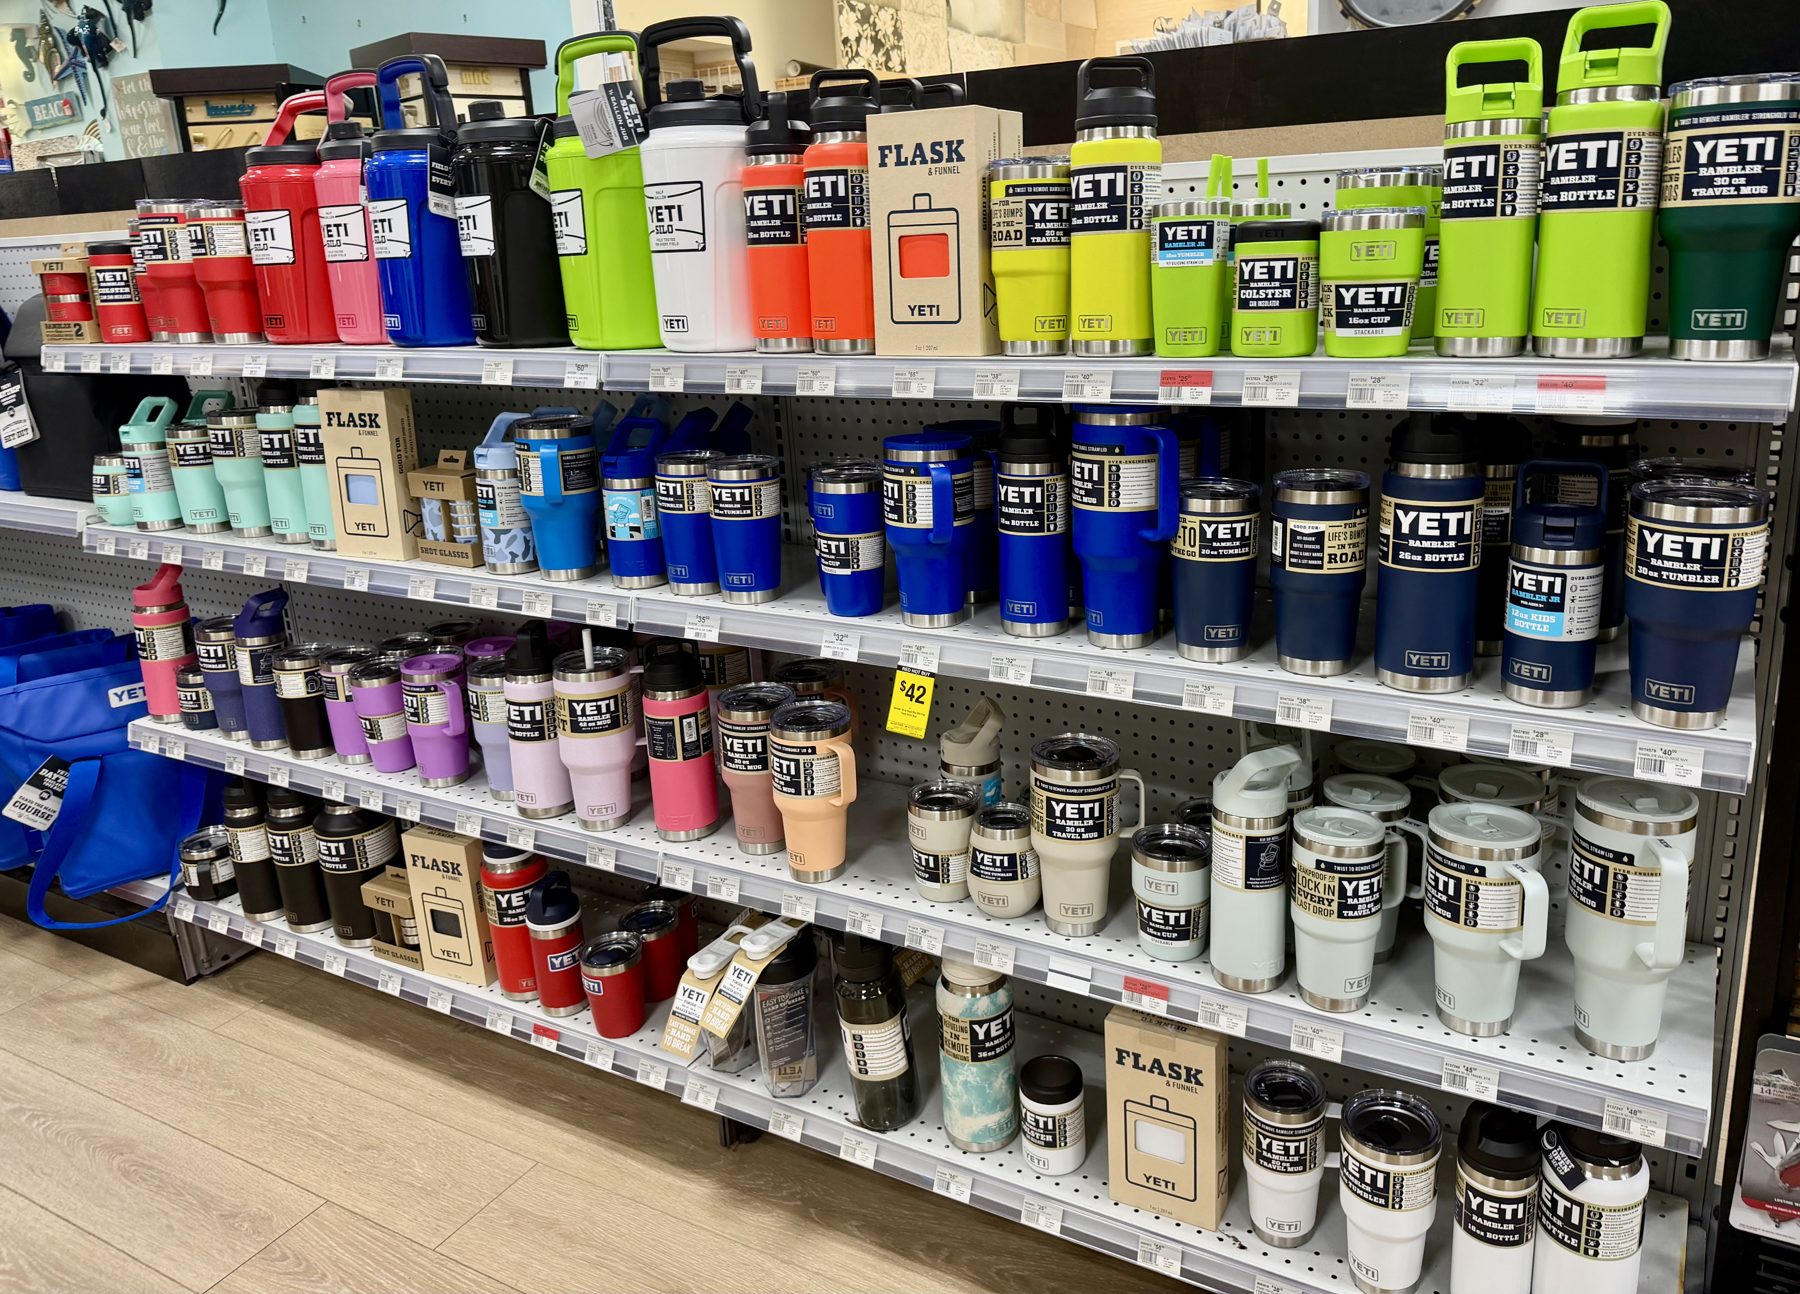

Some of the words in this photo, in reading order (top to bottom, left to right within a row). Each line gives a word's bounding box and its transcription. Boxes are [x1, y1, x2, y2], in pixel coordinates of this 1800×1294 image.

[610, 94, 624, 124] GALLON
[618, 123, 629, 141] JUG
[878, 139, 965, 167] FLASK
[1547, 140, 1619, 171] YETI
[1693, 137, 1775, 164] YETI
[935, 166, 960, 175] FUNNEL
[1443, 155, 1495, 179] YETI
[1699, 165, 1762, 176] RAMBLER
[804, 175, 846, 197] YETI
[1071, 172, 1126, 199] YETI
[1551, 176, 1596, 184] RAMBLER
[1714, 177, 1729, 185] 30
[1560, 190, 1615, 201] BOTTLE
[1692, 187, 1737, 196] TRAVEL
[1740, 186, 1768, 194] MUG
[745, 195, 794, 216] YETI
[1074, 203, 1108, 211] RAMBLER
[1452, 199, 1494, 209] BOTTLE
[649, 204, 683, 223] YETI
[814, 214, 842, 222] BOTTLE
[1008, 208, 1023, 218] BUMPS
[1084, 215, 1118, 224] BOTTLE
[655, 225, 673, 234] SILO
[760, 230, 790, 238] BOTTLE
[1165, 225, 1206, 240] YETI
[1354, 244, 1393, 257] YETI
[42, 262, 63, 270] YETI
[1241, 261, 1294, 280] YETI
[96, 271, 127, 282] YETI
[1240, 289, 1292, 299] COLSTER
[1339, 286, 1401, 305] YETI
[908, 305, 940, 317] YETI
[1546, 311, 1582, 324] YETI
[664, 318, 684, 329] YETI
[760, 320, 785, 328] YETI
[1037, 319, 1065, 329] YETI
[1080, 318, 1109, 329] YETI
[1371, 316, 1390, 324] CUP
[1444, 313, 1480, 324] YETI
[1696, 313, 1741, 327] YETI
[74, 323, 84, 337] 2
[1169, 329, 1204, 342] YETI
[1243, 329, 1278, 342] YETI
[326, 411, 381, 429] FLASK
[176, 443, 210, 454] YETI
[422, 481, 445, 492] YETI
[713, 488, 750, 502] YETI
[1000, 486, 1042, 503] YETI
[192, 510, 214, 519] YETI
[1002, 506, 1033, 514] RAMBLER
[354, 522, 375, 532] YETI
[1396, 509, 1472, 536] YETI
[1202, 522, 1250, 539] YETI
[1328, 531, 1348, 542] LIFE'S
[1349, 528, 1365, 541] BUMPS
[1408, 539, 1455, 548] RAMBLER
[1642, 529, 1721, 560] YETI
[420, 547, 438, 557] SHOT
[439, 548, 469, 560] GLASSES
[1328, 551, 1364, 564] ROAD
[1424, 553, 1464, 562] BOTTLE
[1650, 557, 1701, 571] RAMBLER
[727, 575, 751, 584] YETI
[1512, 569, 1563, 594] YETI
[1662, 572, 1719, 584] TUMBLER
[1511, 589, 1547, 602] RAMBLER
[1008, 603, 1033, 614] YETI
[1530, 613, 1556, 623] KIDS
[1514, 619, 1550, 632] BOTTLE
[1208, 628, 1239, 638] YETI
[1409, 654, 1446, 667] YETI
[1512, 662, 1547, 679] YETI
[900, 680, 927, 705] $42
[1649, 682, 1689, 701] YETI
[572, 699, 615, 716] YETI
[577, 714, 611, 722] RAMBLER
[723, 736, 762, 752] YETI
[726, 762, 746, 771] TRAVEL
[12, 801, 53, 821] COURSE
[589, 805, 614, 815] YETI
[1050, 800, 1099, 818] YETI
[1056, 819, 1093, 827] RAMBLER
[411, 854, 463, 876] FLASK
[975, 851, 1008, 867] YETI
[1298, 864, 1328, 881] LEAKPROOF
[1146, 879, 1175, 893] YETI
[1297, 873, 1320, 893] LOCK
[1323, 883, 1335, 896] IN
[374, 895, 395, 908] YETI
[980, 894, 1005, 905] YETI
[1297, 888, 1335, 907] EVERY
[1579, 897, 1596, 908] MUG
[1062, 905, 1091, 916] YETI
[1140, 904, 1186, 925] YETI
[1296, 900, 1311, 912] LAST
[1313, 905, 1334, 917] DROP
[440, 948, 460, 960] YETI
[732, 966, 753, 984] YETI
[682, 986, 705, 1003] YETI
[762, 998, 777, 1008] EASY
[950, 1032, 960, 1040] IN
[665, 1035, 672, 1045] TO
[672, 1039, 692, 1054] BREAK
[945, 1039, 969, 1054] REMOTE
[1115, 1047, 1204, 1087] FLASK
[1172, 1081, 1199, 1094] FUNNEL
[1258, 1133, 1307, 1154] YETI
[1262, 1151, 1300, 1162] RAMBLER
[1551, 1149, 1570, 1174] OPEN
[1556, 1146, 1575, 1169] TWIST
[1259, 1159, 1286, 1171] TRAVEL
[1340, 1142, 1385, 1189] YETI
[1143, 1173, 1176, 1191] YETI
[1348, 1180, 1385, 1205] TUMBLER
[1467, 1190, 1524, 1219] YETI
[1268, 1220, 1298, 1231] YETI
[1472, 1214, 1514, 1230] RAMBLER
[1486, 1231, 1519, 1241] BOTTLE
[1352, 1255, 1375, 1278] YETI
